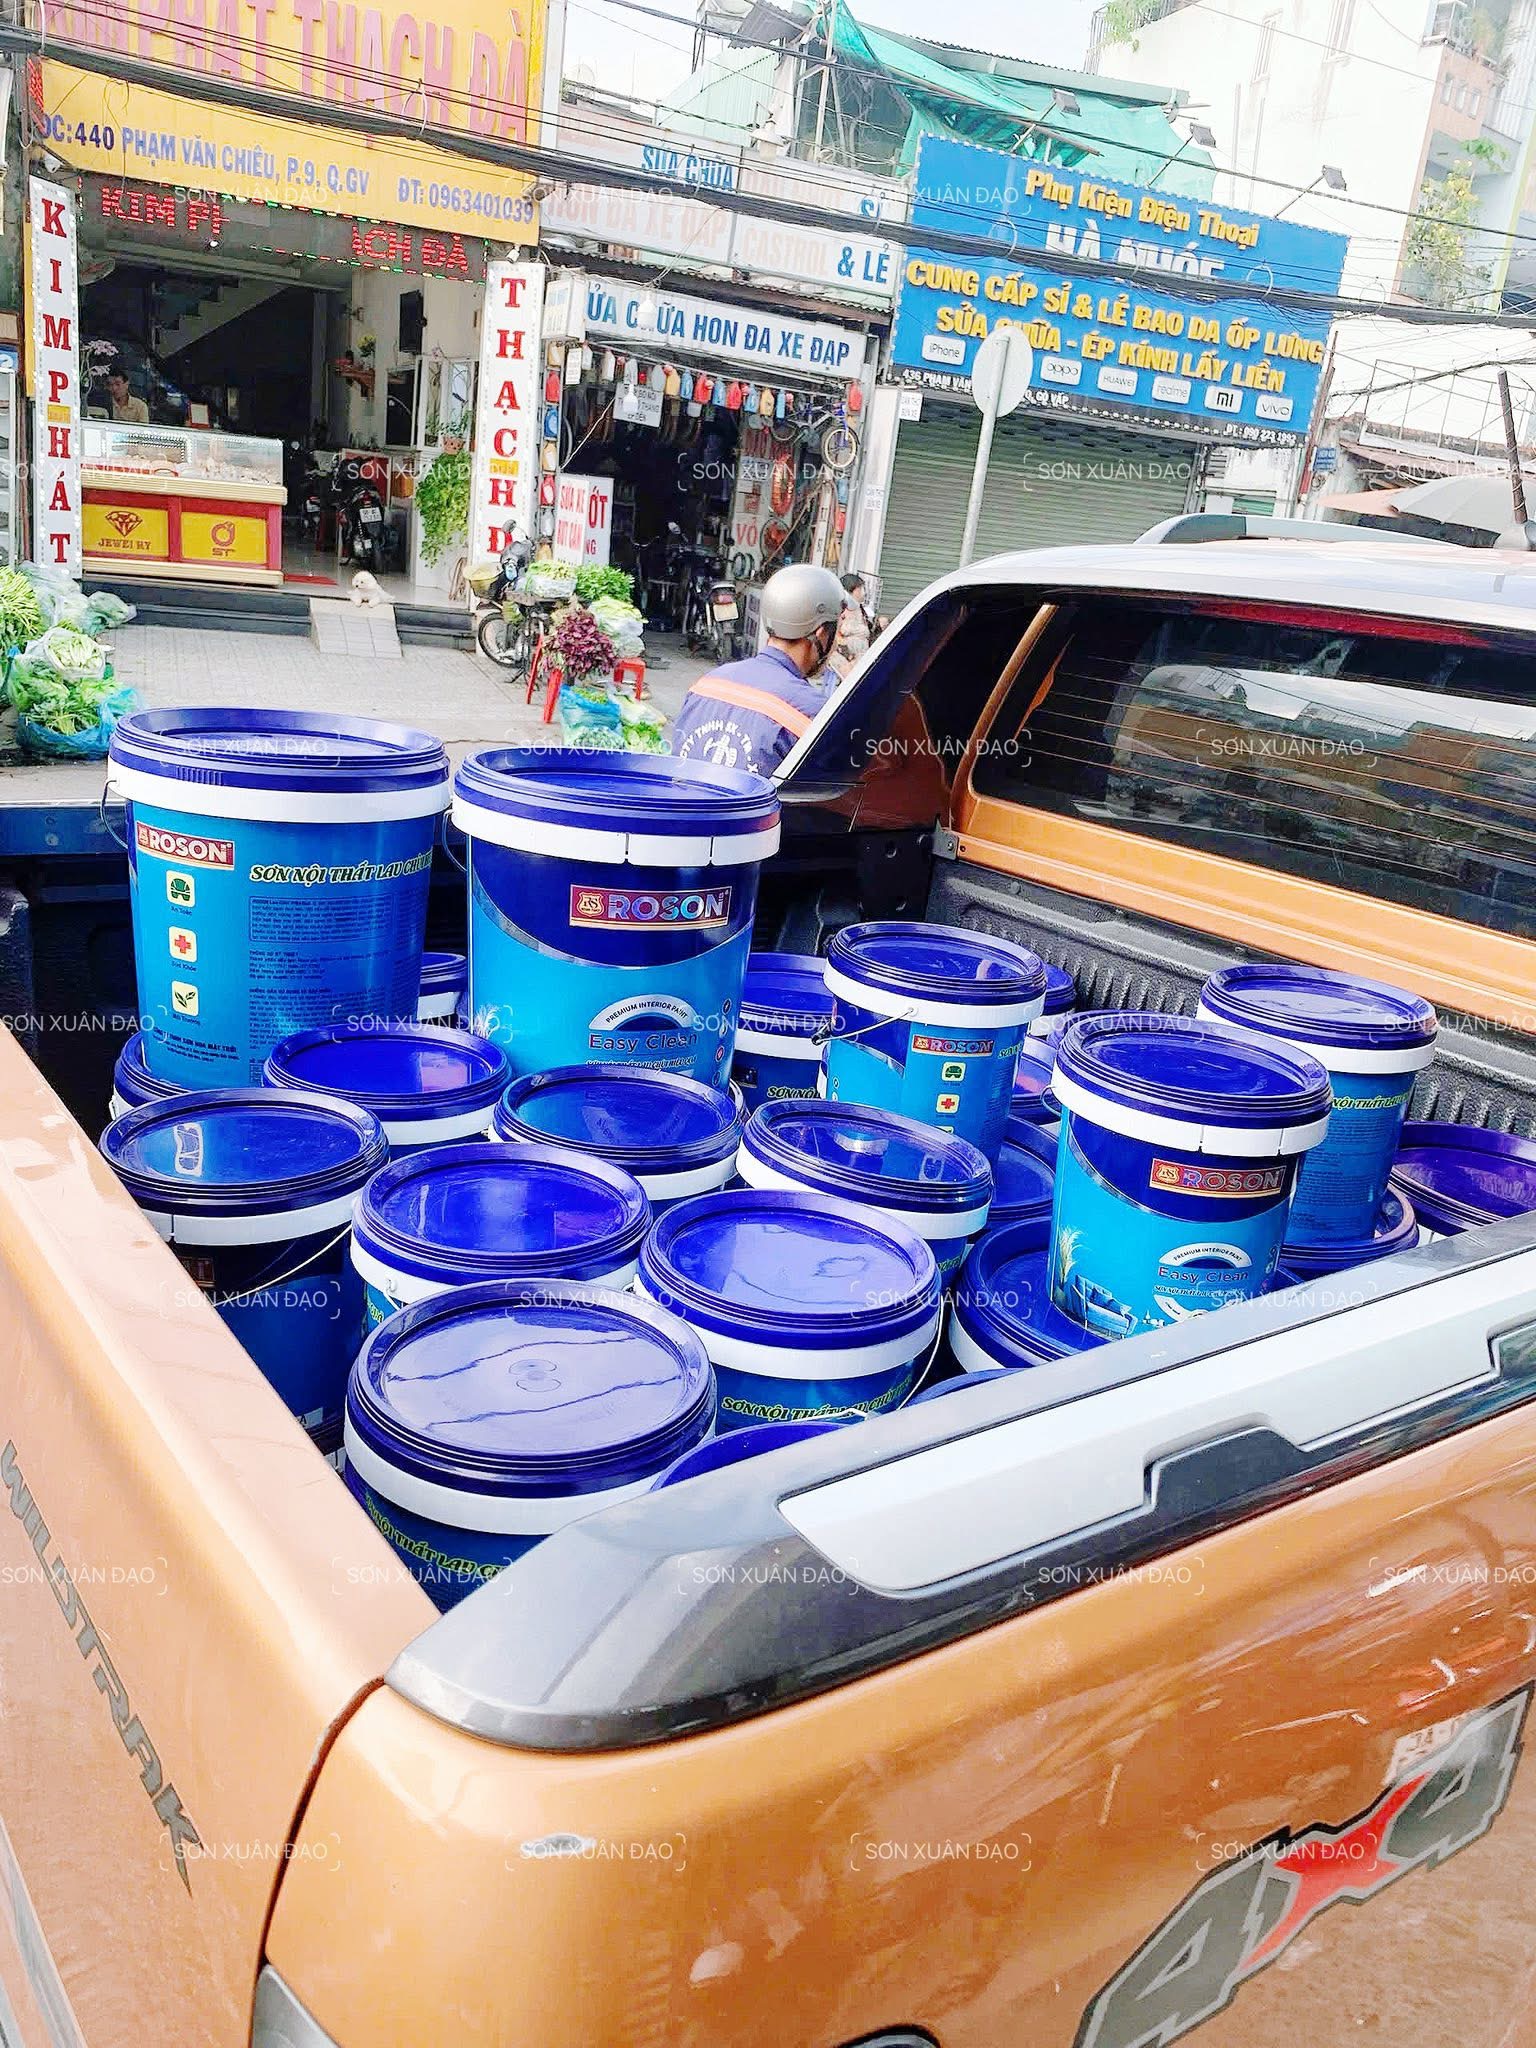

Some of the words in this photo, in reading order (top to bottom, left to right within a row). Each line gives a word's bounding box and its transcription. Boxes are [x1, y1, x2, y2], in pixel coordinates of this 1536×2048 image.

[122, 127, 176, 167] PHẠM
[181, 136, 216, 169] VĂN
[101, 186, 176, 228] KIM
[398, 177, 425, 205] ĐT:
[428, 182, 534, 225] 0963401039
[1025, 167, 1074, 210] Phụ
[1078, 182, 1133, 220] Kiện
[1139, 196, 1191, 233] Điện
[1199, 209, 1260, 250] Thoại
[837, 246, 857, 278] &
[862, 242, 892, 284] LẺ
[906, 260, 981, 298] CUNG
[984, 271, 1039, 307] CẤP
[1043, 280, 1073, 315] SỈ
[1071, 294, 1093, 320] &
[1097, 292, 1131, 327] LẺ
[1132, 304, 1185, 337] BAO
[1188, 316, 1221, 345] DA
[1225, 316, 1262, 350] ỐP
[588, 283, 618, 325] ỬA
[625, 300, 686, 339] CỮA
[693, 315, 739, 347] HON
[743, 323, 772, 354] ĐA
[777, 329, 805, 357] XE
[809, 336, 852, 371] ĐẠP
[929, 341, 961, 359] iPhone
[937, 301, 988, 340] SỬA
[1081, 328, 1117, 362] ÉP
[1118, 338, 1179, 374] KÍNH
[1181, 349, 1230, 383] LẤY
[1046, 362, 1079, 377] oppo
[1103, 375, 1136, 388] HUAWEI
[1157, 383, 1188, 398] realme
[695, 719, 724, 740] TNHH
[149, 829, 228, 863] ROSON
[251, 863, 291, 883] SƠN
[293, 863, 326, 887] NỘI
[330, 860, 375, 883] THẤT
[375, 860, 402, 879] LAU
[607, 894, 727, 921] ROSON
[605, 1004, 638, 1024] PREMIUM
[638, 1001, 671, 1009] INTERIOR
[589, 1034, 638, 1054] Easy
[646, 1031, 698, 1050] Clean
[929, 1040, 993, 1053] ROSON
[1182, 1168, 1281, 1192] ROSON
[1158, 1266, 1200, 1284] Easy
[1205, 1271, 1250, 1283] Clean
[722, 1396, 756, 1415] SƠN
[755, 1402, 790, 1421] NỘI
[436, 1551, 478, 1574] LAU
